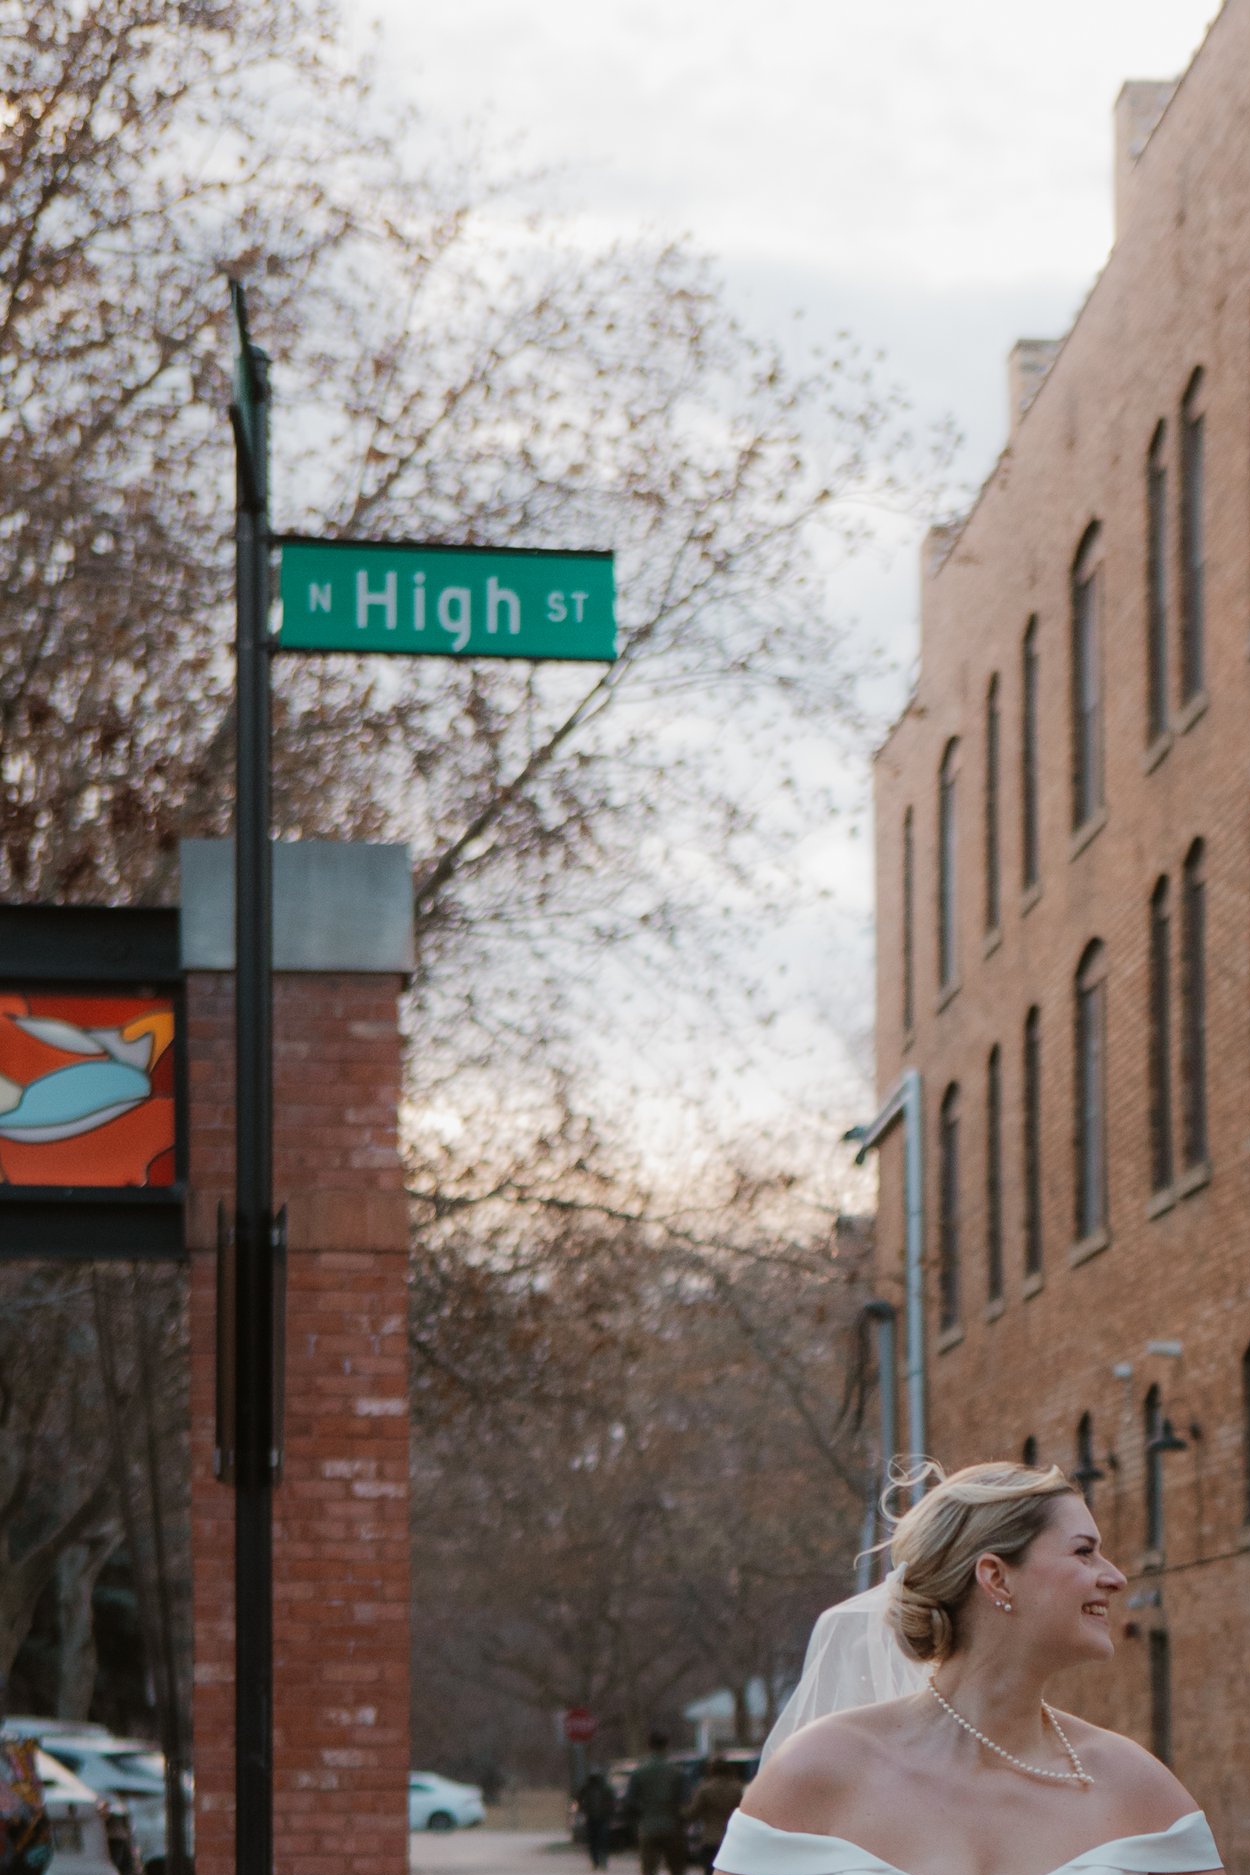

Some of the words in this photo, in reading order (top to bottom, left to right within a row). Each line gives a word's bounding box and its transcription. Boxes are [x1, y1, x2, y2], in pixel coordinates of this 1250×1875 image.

[308, 582, 332, 613] N
[356, 569, 521, 652] High
[547, 590, 589, 623] ST
